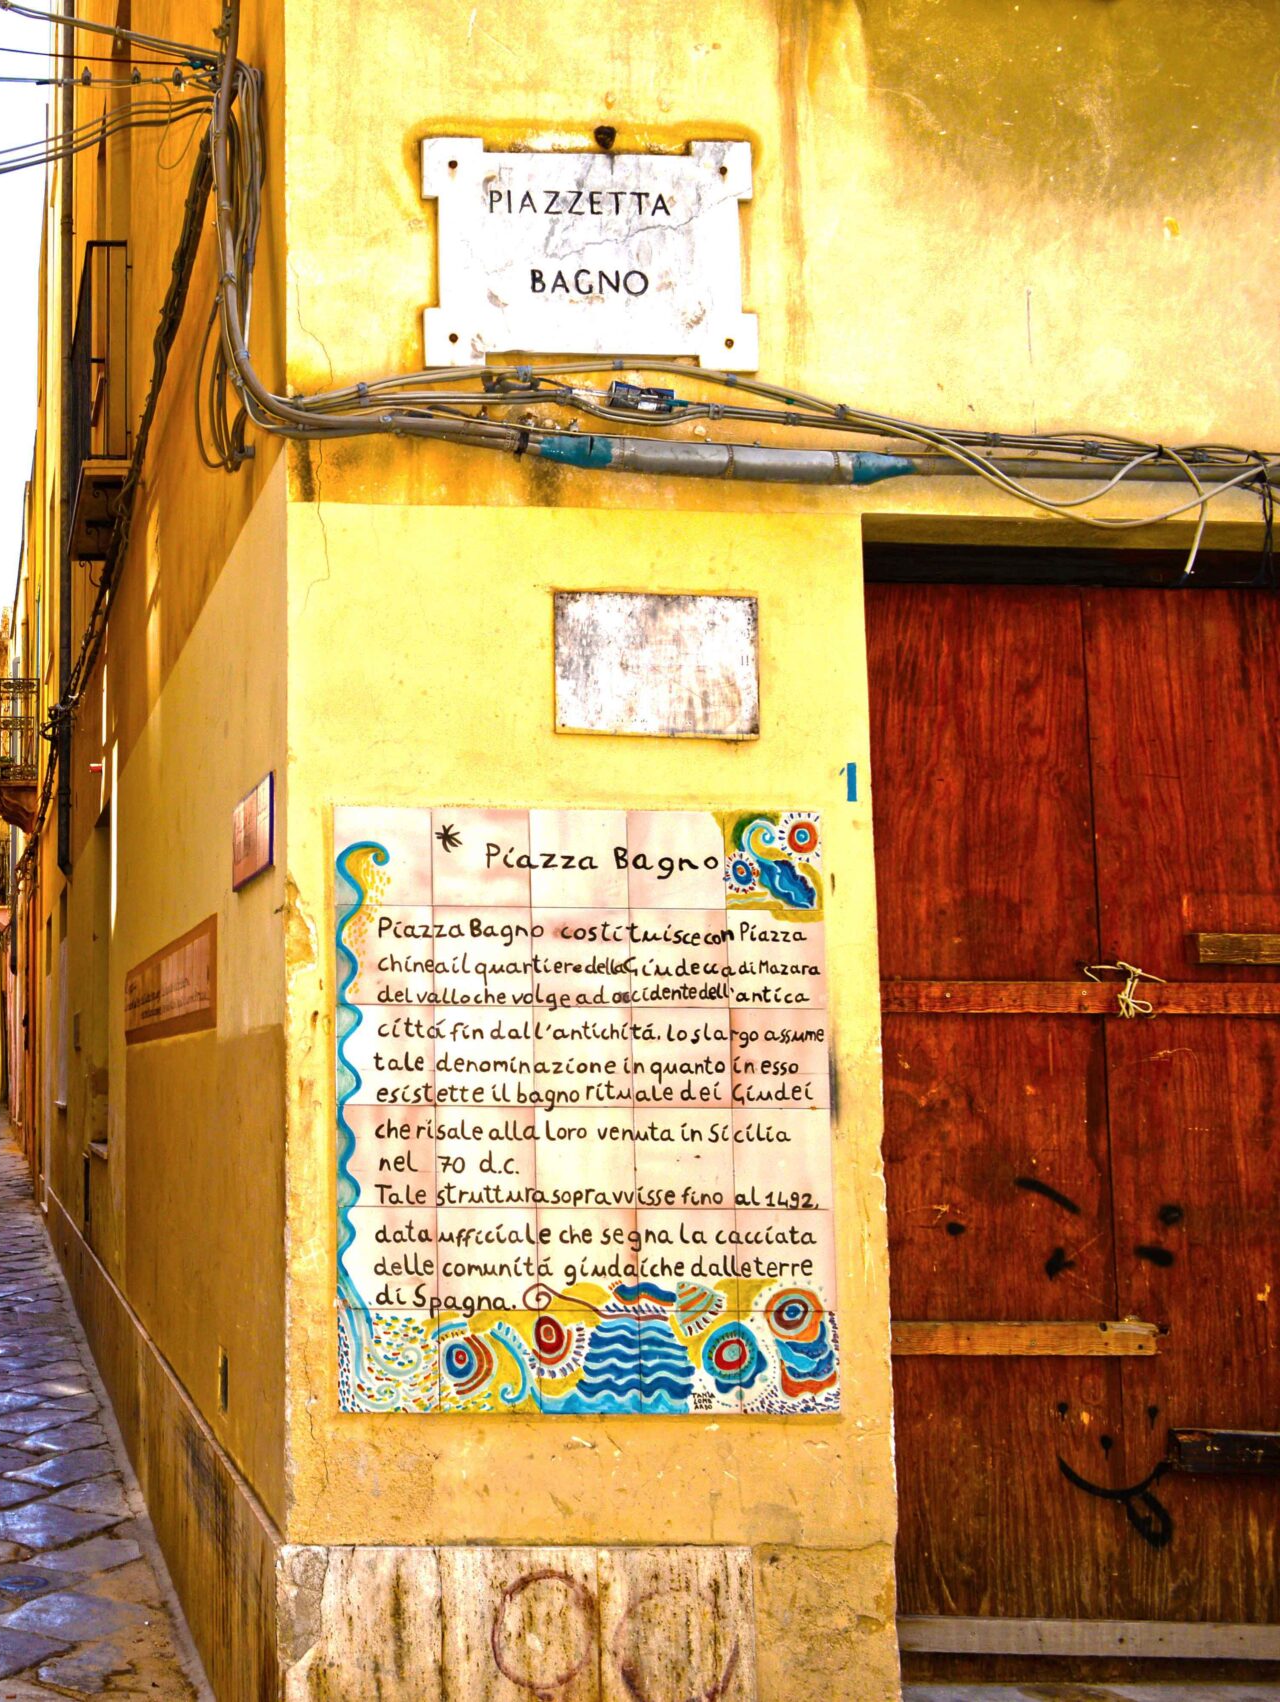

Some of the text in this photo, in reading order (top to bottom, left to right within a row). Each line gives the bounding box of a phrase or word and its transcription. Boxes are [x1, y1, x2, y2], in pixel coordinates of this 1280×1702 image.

[488, 190, 671, 216] PIAZZETTA
[530, 269, 649, 297] BAGNO
[486, 843, 719, 880] Piazza Bagno
[377, 916, 808, 947] Piazza Bagno costituisce con Piazza
[474, 954, 583, 987] quartiere
[584, 956, 625, 976] della
[623, 956, 737, 978] Giudecca
[738, 961, 757, 976] di
[758, 960, 821, 976] Mazara
[377, 985, 413, 1004] del
[416, 987, 471, 1005] vallo
[473, 988, 507, 1006] che
[511, 983, 572, 1011] volge
[575, 985, 610, 1005] ad
[611, 983, 697, 1003] occidente
[450, 1022, 484, 1042] fin
[690, 1022, 759, 1048] slargo
[764, 1028, 825, 1043] assume
[373, 1051, 799, 1084] tale denominazione in quanto in esso
[376, 1080, 814, 1112] esistette il bagno rituale dei Giudei
[374, 1118, 792, 1143] che risale alla loro venuta in Sicilia
[378, 1150, 419, 1172] nel
[437, 1155, 466, 1174] 70
[374, 1183, 427, 1205] Tale
[436, 1182, 547, 1206] struttura
[550, 1185, 676, 1207] sopravvisse
[681, 1186, 724, 1206] fino
[734, 1186, 760, 1206] al
[374, 1219, 817, 1252] data ufficiale che segna la cacciata
[373, 1252, 435, 1276] delle
[563, 1253, 685, 1286] giudaiche
[690, 1254, 752, 1278] dalle
[753, 1258, 814, 1278] terre
[375, 1283, 517, 1318] di Spagna.
